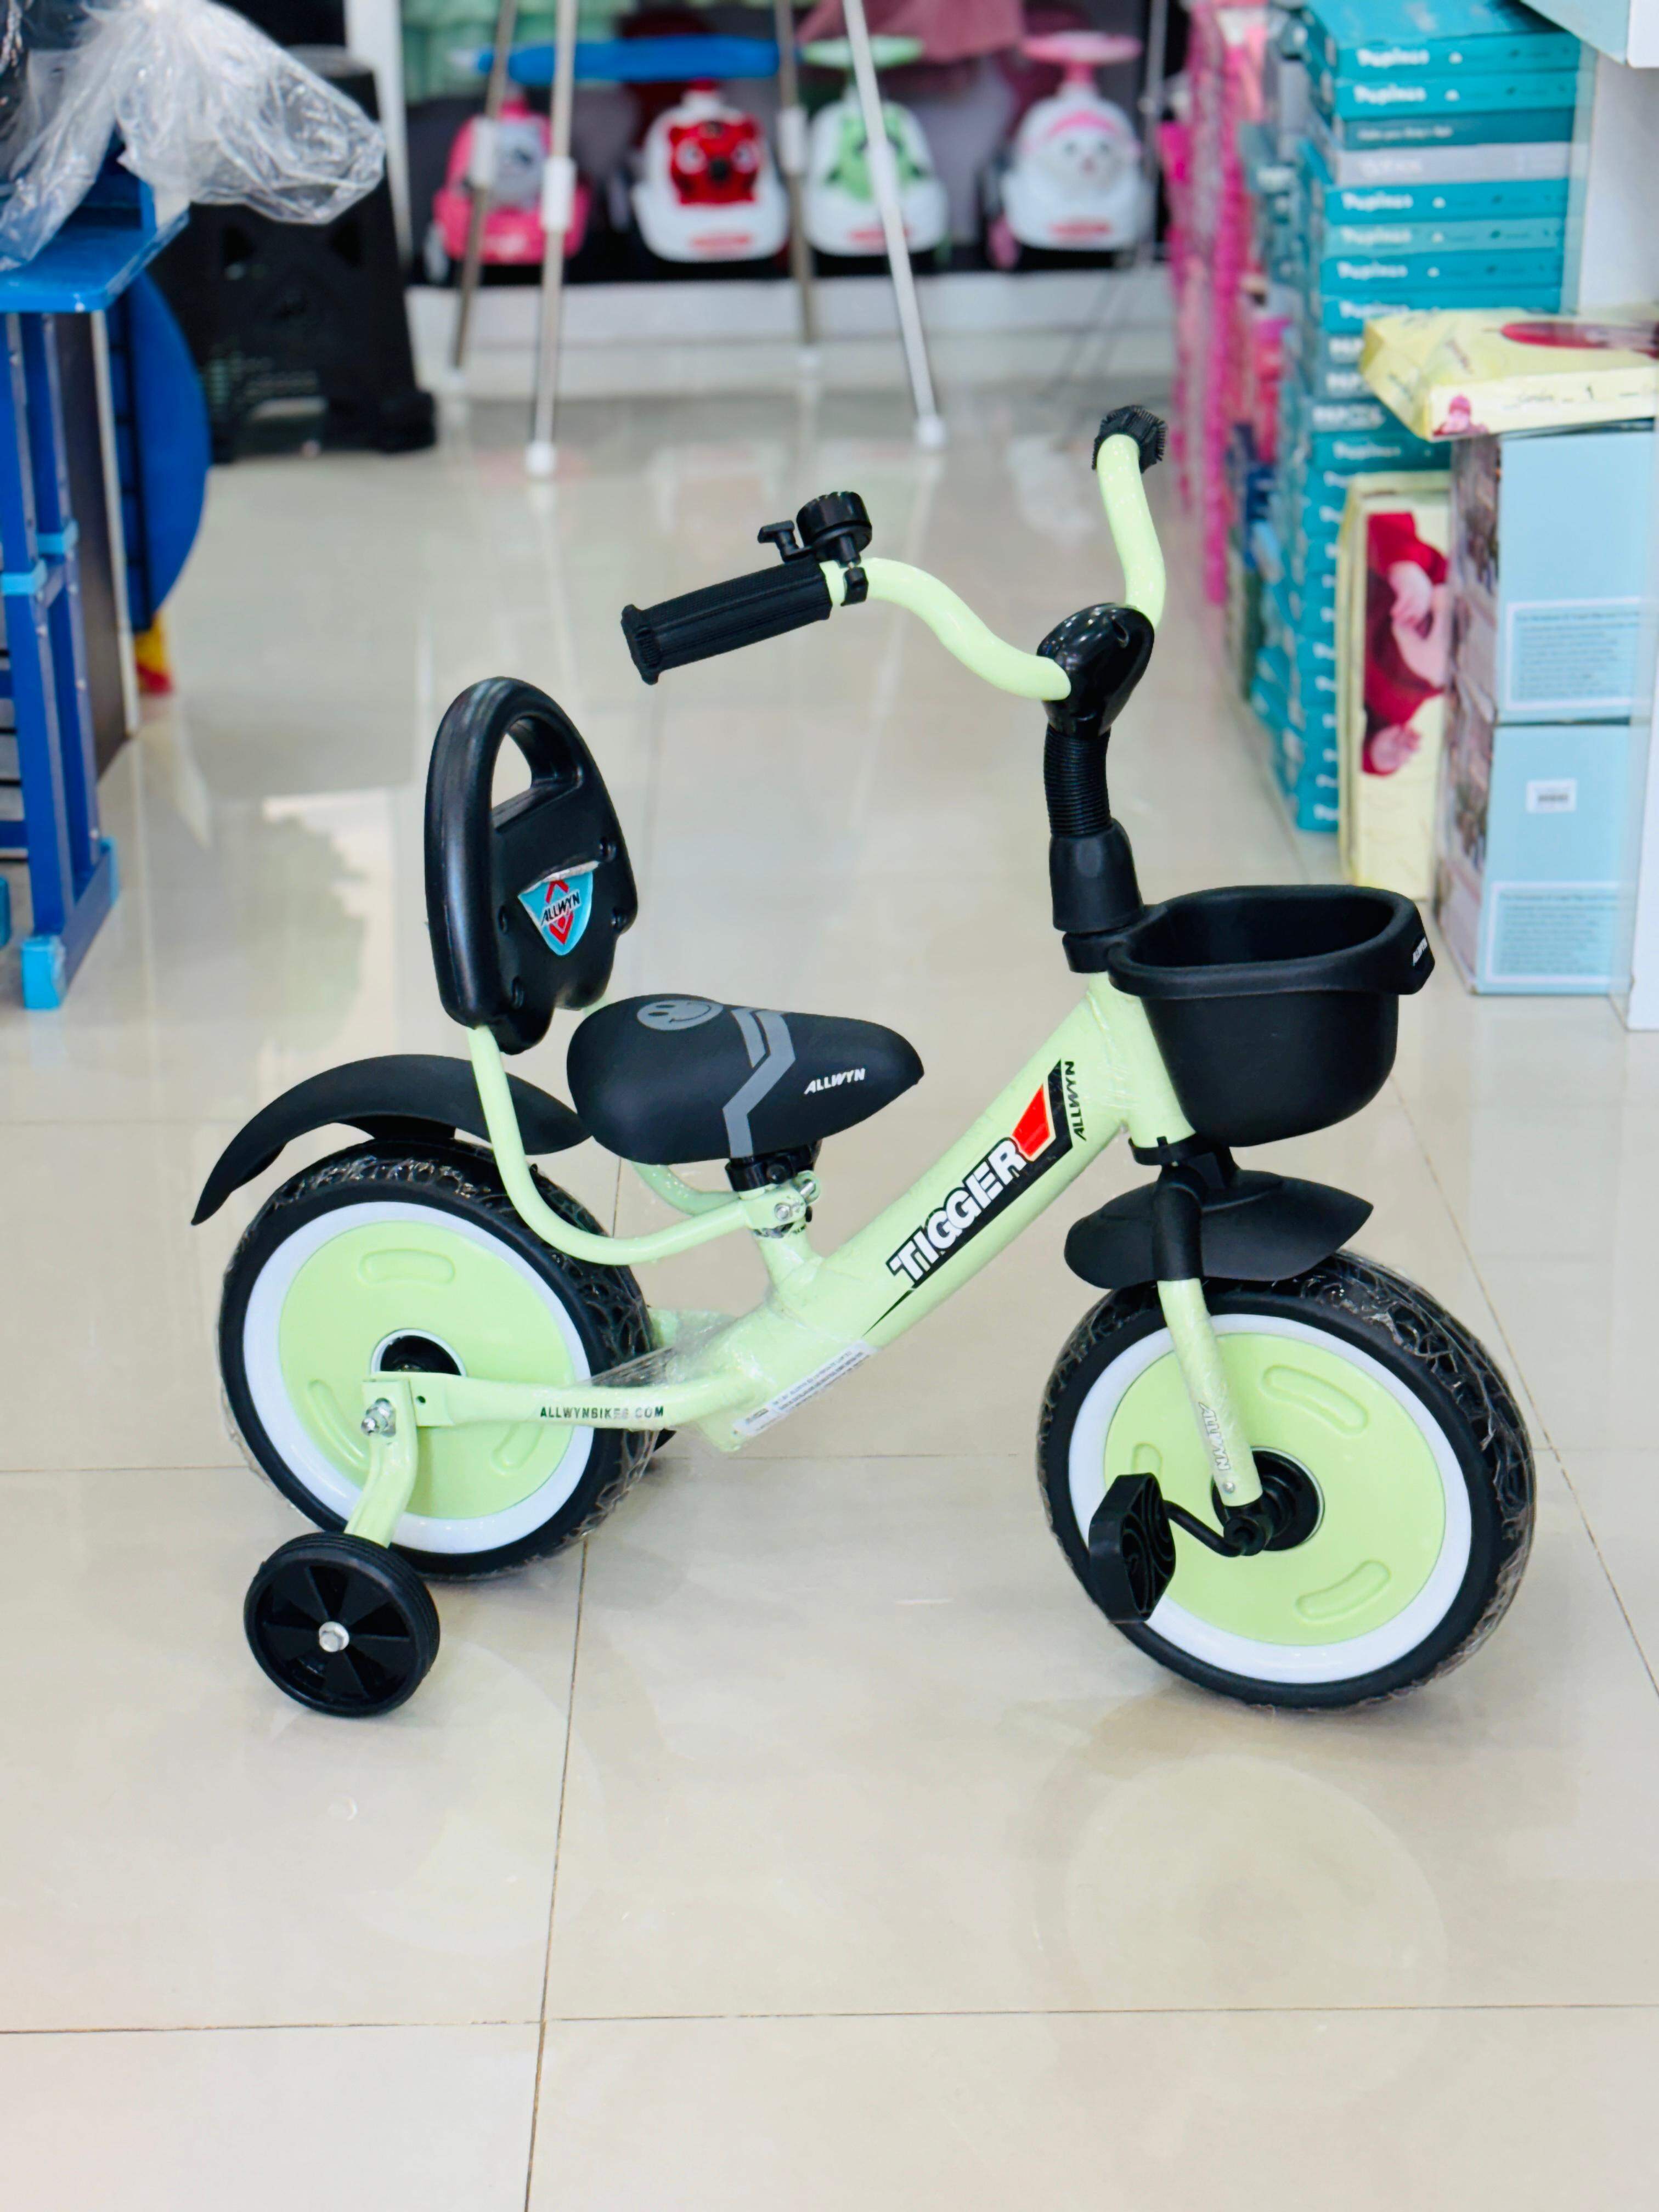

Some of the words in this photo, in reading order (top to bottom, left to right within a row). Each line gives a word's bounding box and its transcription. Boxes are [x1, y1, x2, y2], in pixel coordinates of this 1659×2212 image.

[541, 890, 580, 926] ALLWYN
[804, 1068, 866, 1094] ALLWYN
[1065, 1061, 1086, 1141] ALLWYN
[888, 1138, 1028, 1281] TIGGER
[1198, 1402, 1231, 1471] ALLWYN
